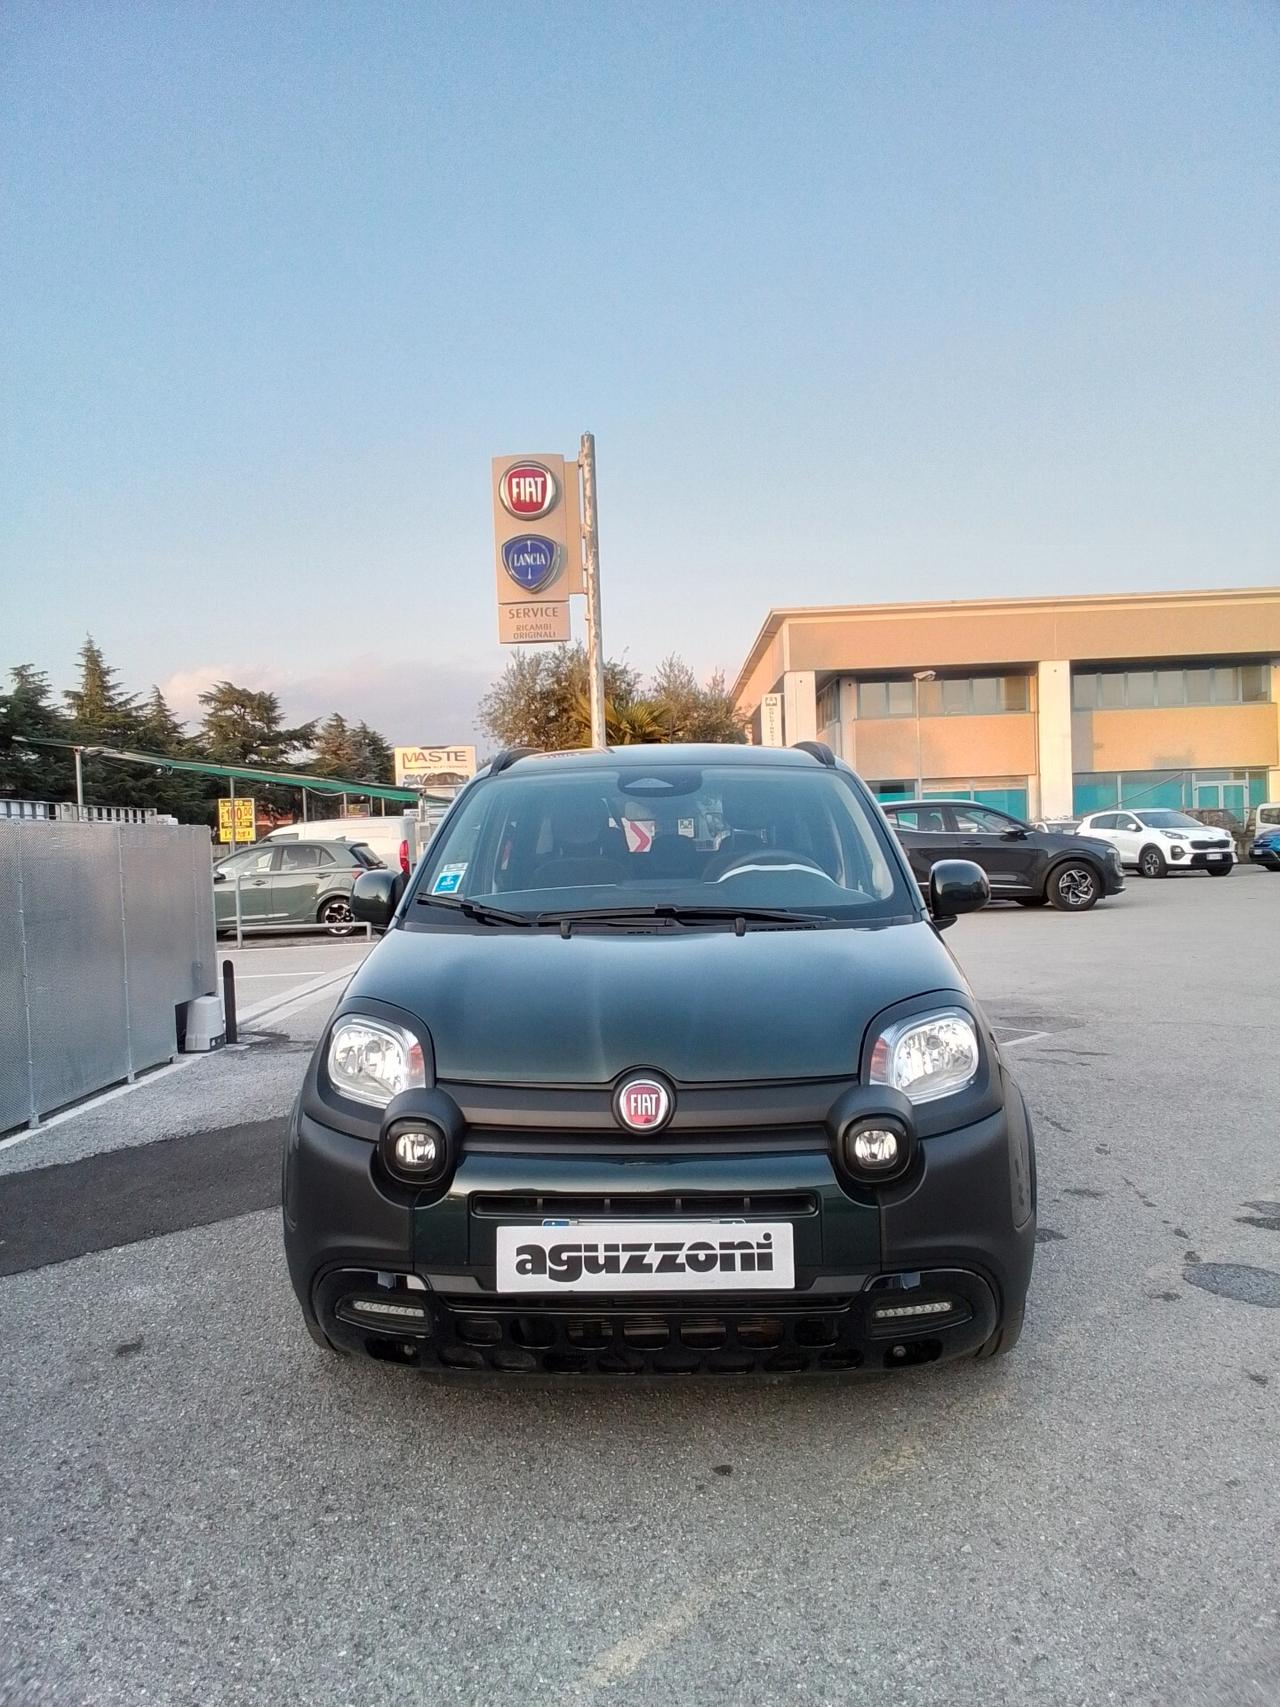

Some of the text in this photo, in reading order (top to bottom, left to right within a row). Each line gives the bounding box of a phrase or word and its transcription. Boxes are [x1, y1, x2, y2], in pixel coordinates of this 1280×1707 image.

[511, 477, 545, 503] FIAT
[513, 553, 546, 567] LANCIA
[508, 607, 559, 619] SERVICE
[516, 623, 552, 631] RICAMBI
[513, 631, 556, 640] ORIGINALI
[630, 1093, 658, 1117] FIAT
[515, 1232, 774, 1283] aguzzoni
